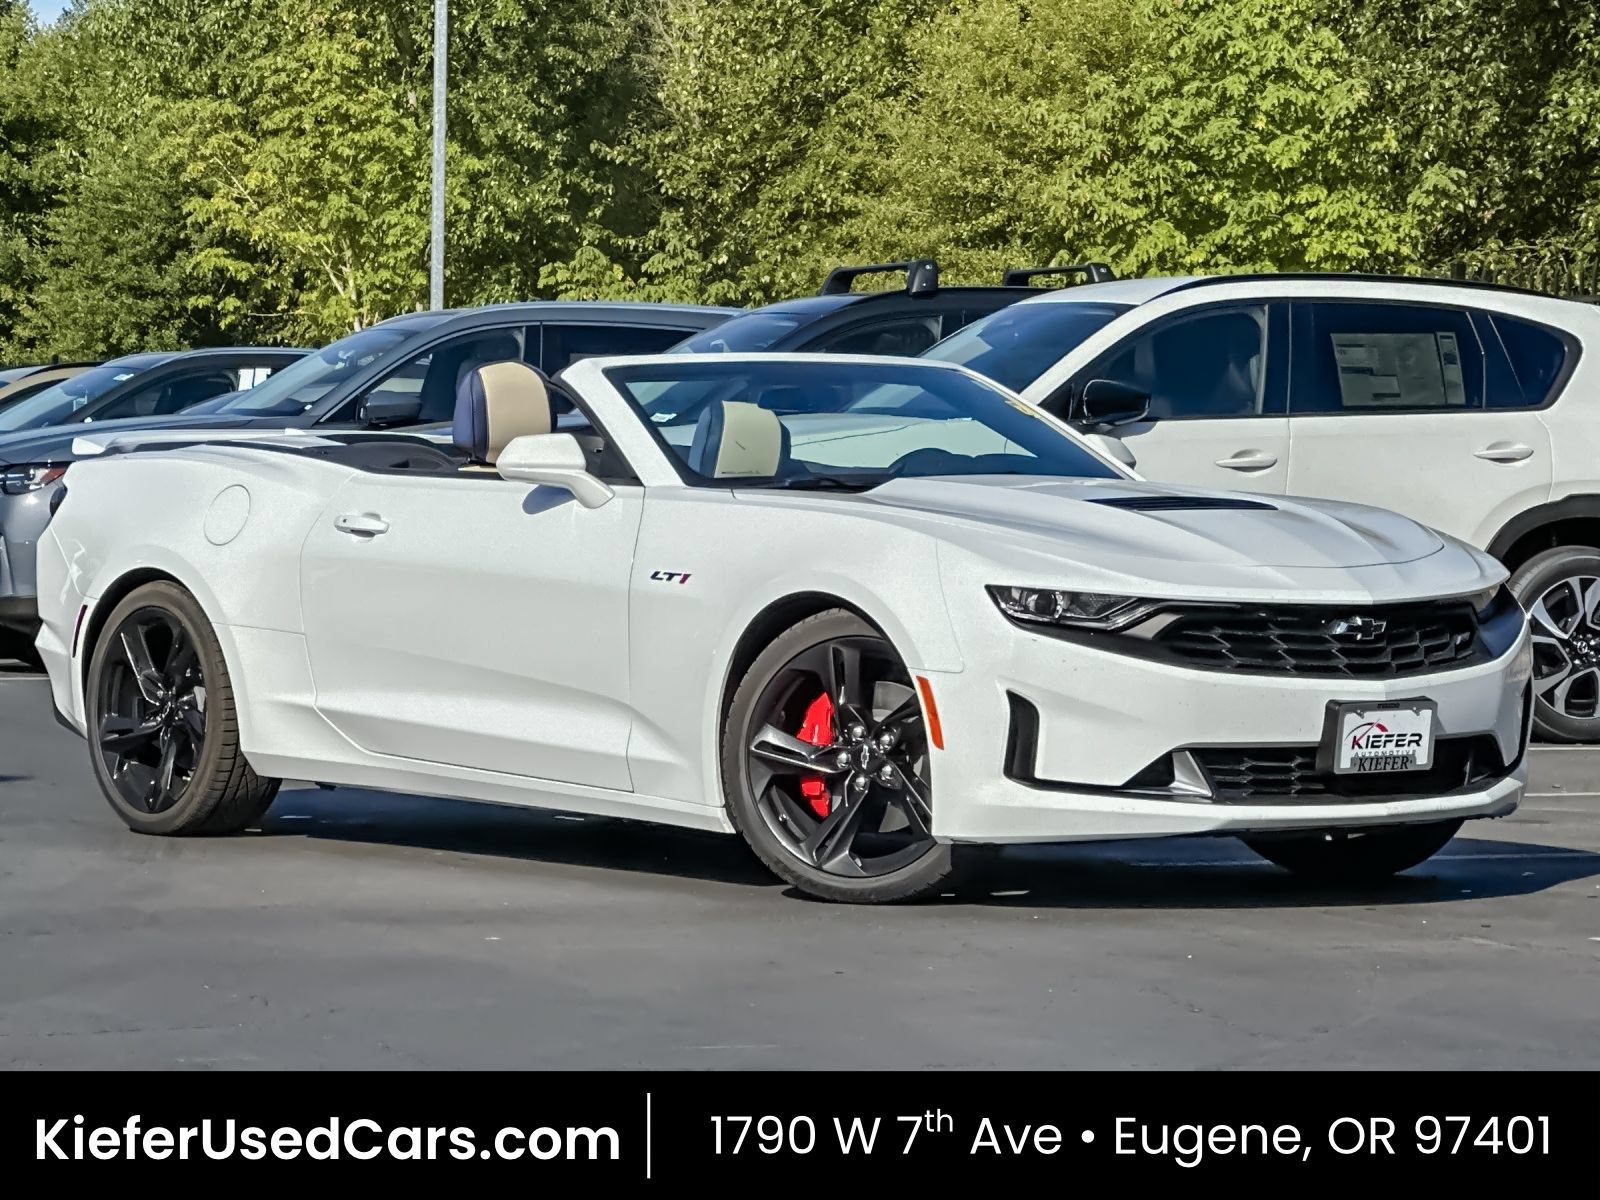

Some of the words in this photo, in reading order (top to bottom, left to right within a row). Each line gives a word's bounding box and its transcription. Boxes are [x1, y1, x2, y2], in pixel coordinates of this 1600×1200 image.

[1351, 733, 1423, 750] KIEFER
[1354, 750, 1416, 758] AUTOMOTIVE
[1357, 756, 1409, 772] KIEFER
